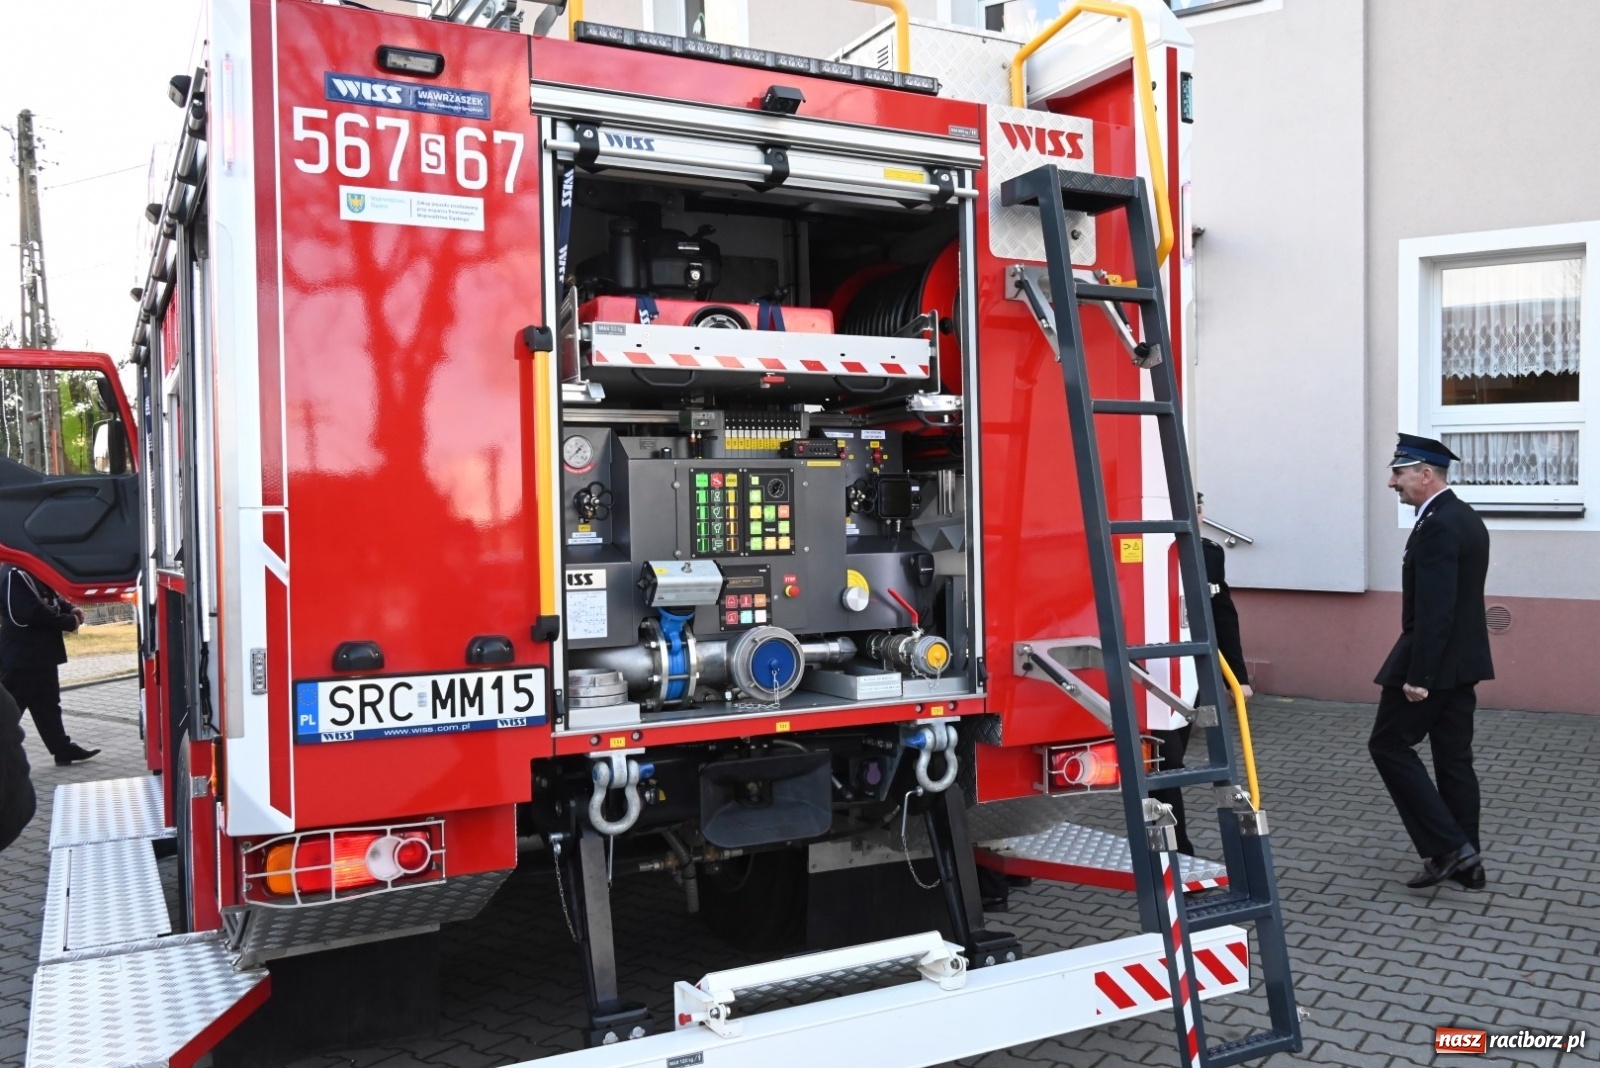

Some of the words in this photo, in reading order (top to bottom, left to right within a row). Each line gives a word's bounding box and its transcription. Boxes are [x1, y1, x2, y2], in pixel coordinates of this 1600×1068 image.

[331, 78, 402, 104] WISS
[417, 90, 484, 106] WAWRZASZEK
[604, 132, 655, 151] WISS
[998, 121, 1084, 160] WISS
[293, 106, 410, 182] 567
[423, 136, 442, 171] S
[455, 127, 524, 194] 67
[562, 168, 574, 208] WISS
[567, 573, 593, 586] ISS
[329, 682, 413, 726] SRC
[431, 673, 534, 719] MM15
[300, 714, 316, 726] PL
[497, 717, 526, 728] WISS
[322, 731, 353, 742] WISS
[383, 722, 470, 736] www.wiss.com.pl
